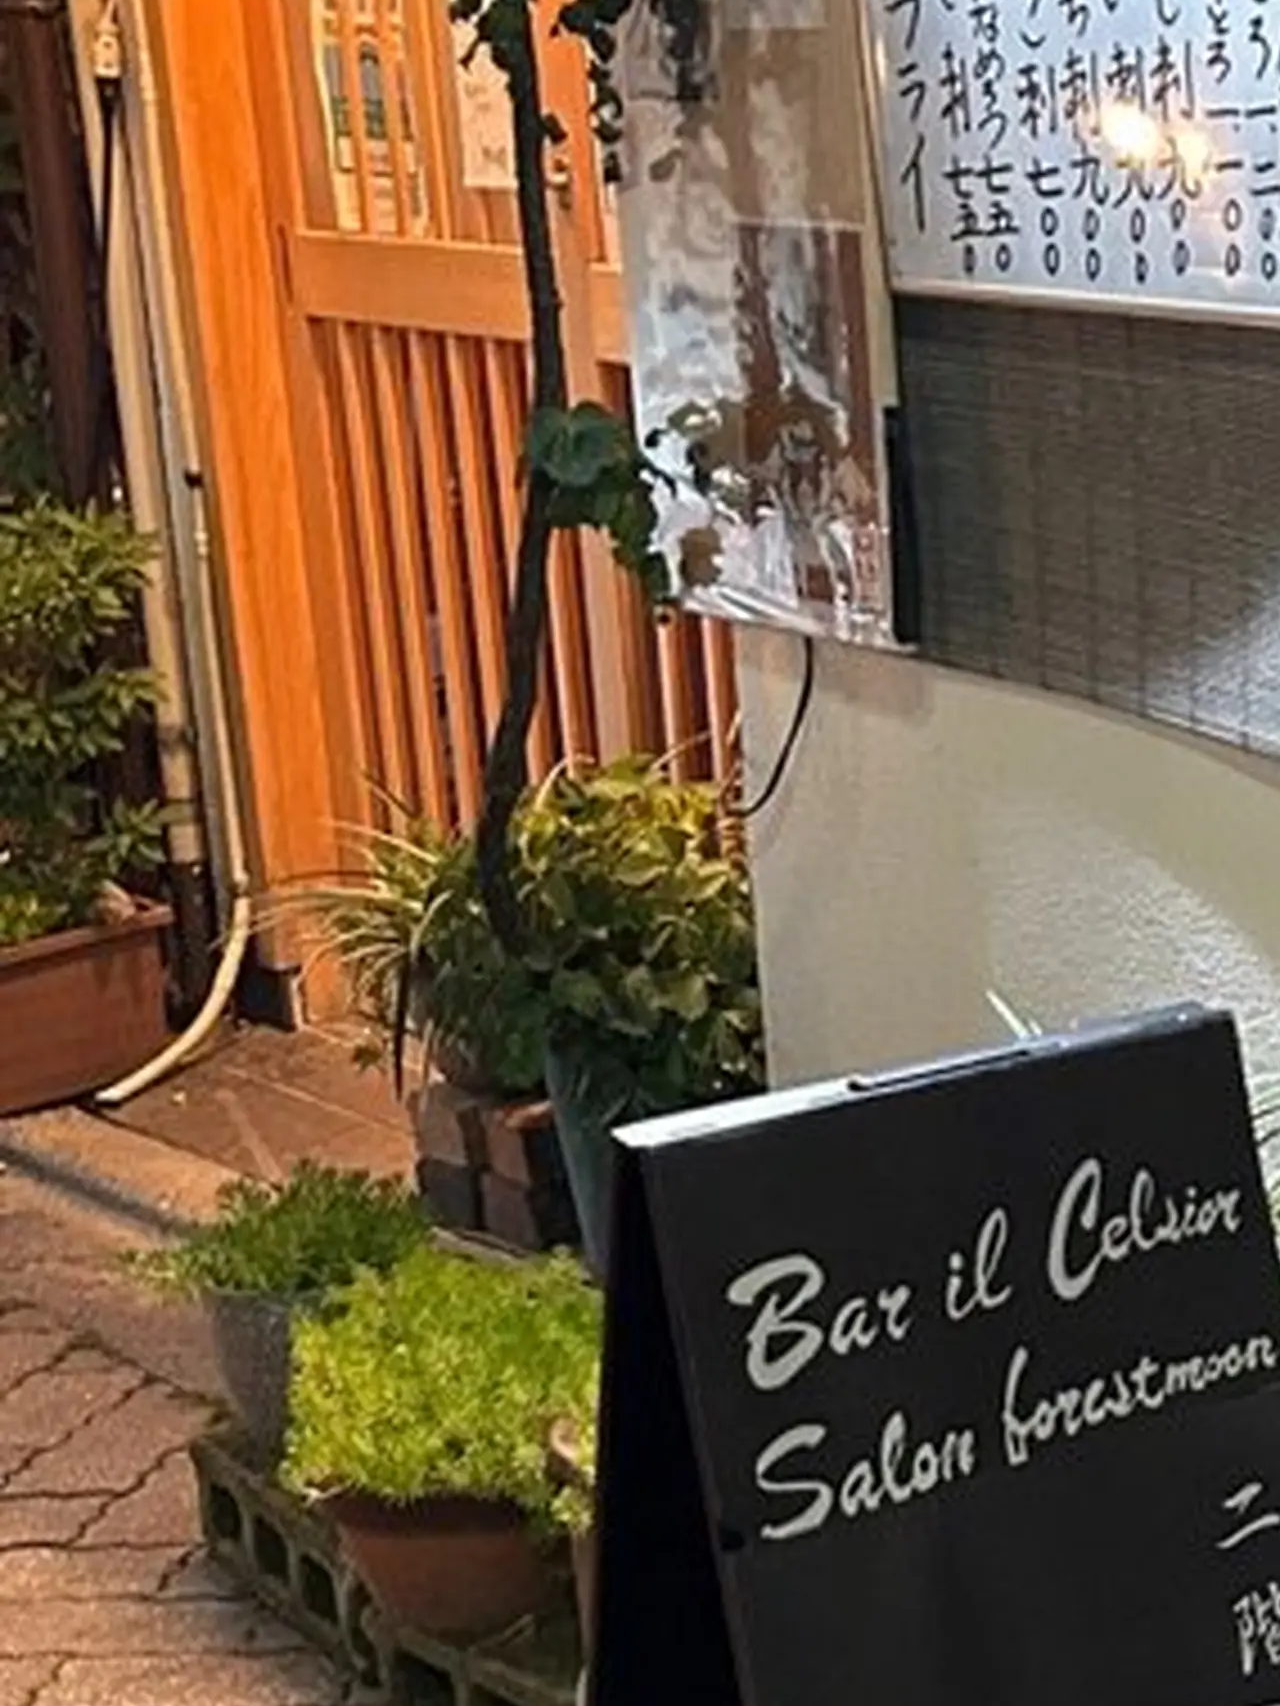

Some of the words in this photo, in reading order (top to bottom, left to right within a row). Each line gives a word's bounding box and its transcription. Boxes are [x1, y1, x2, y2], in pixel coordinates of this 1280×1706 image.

[726, 1253, 912, 1391] Bar
[944, 1207, 1012, 1321] il
[1046, 1158, 1241, 1300] Celsior
[754, 1409, 976, 1540] Salon
[1003, 1346, 1280, 1466] forestmoon
